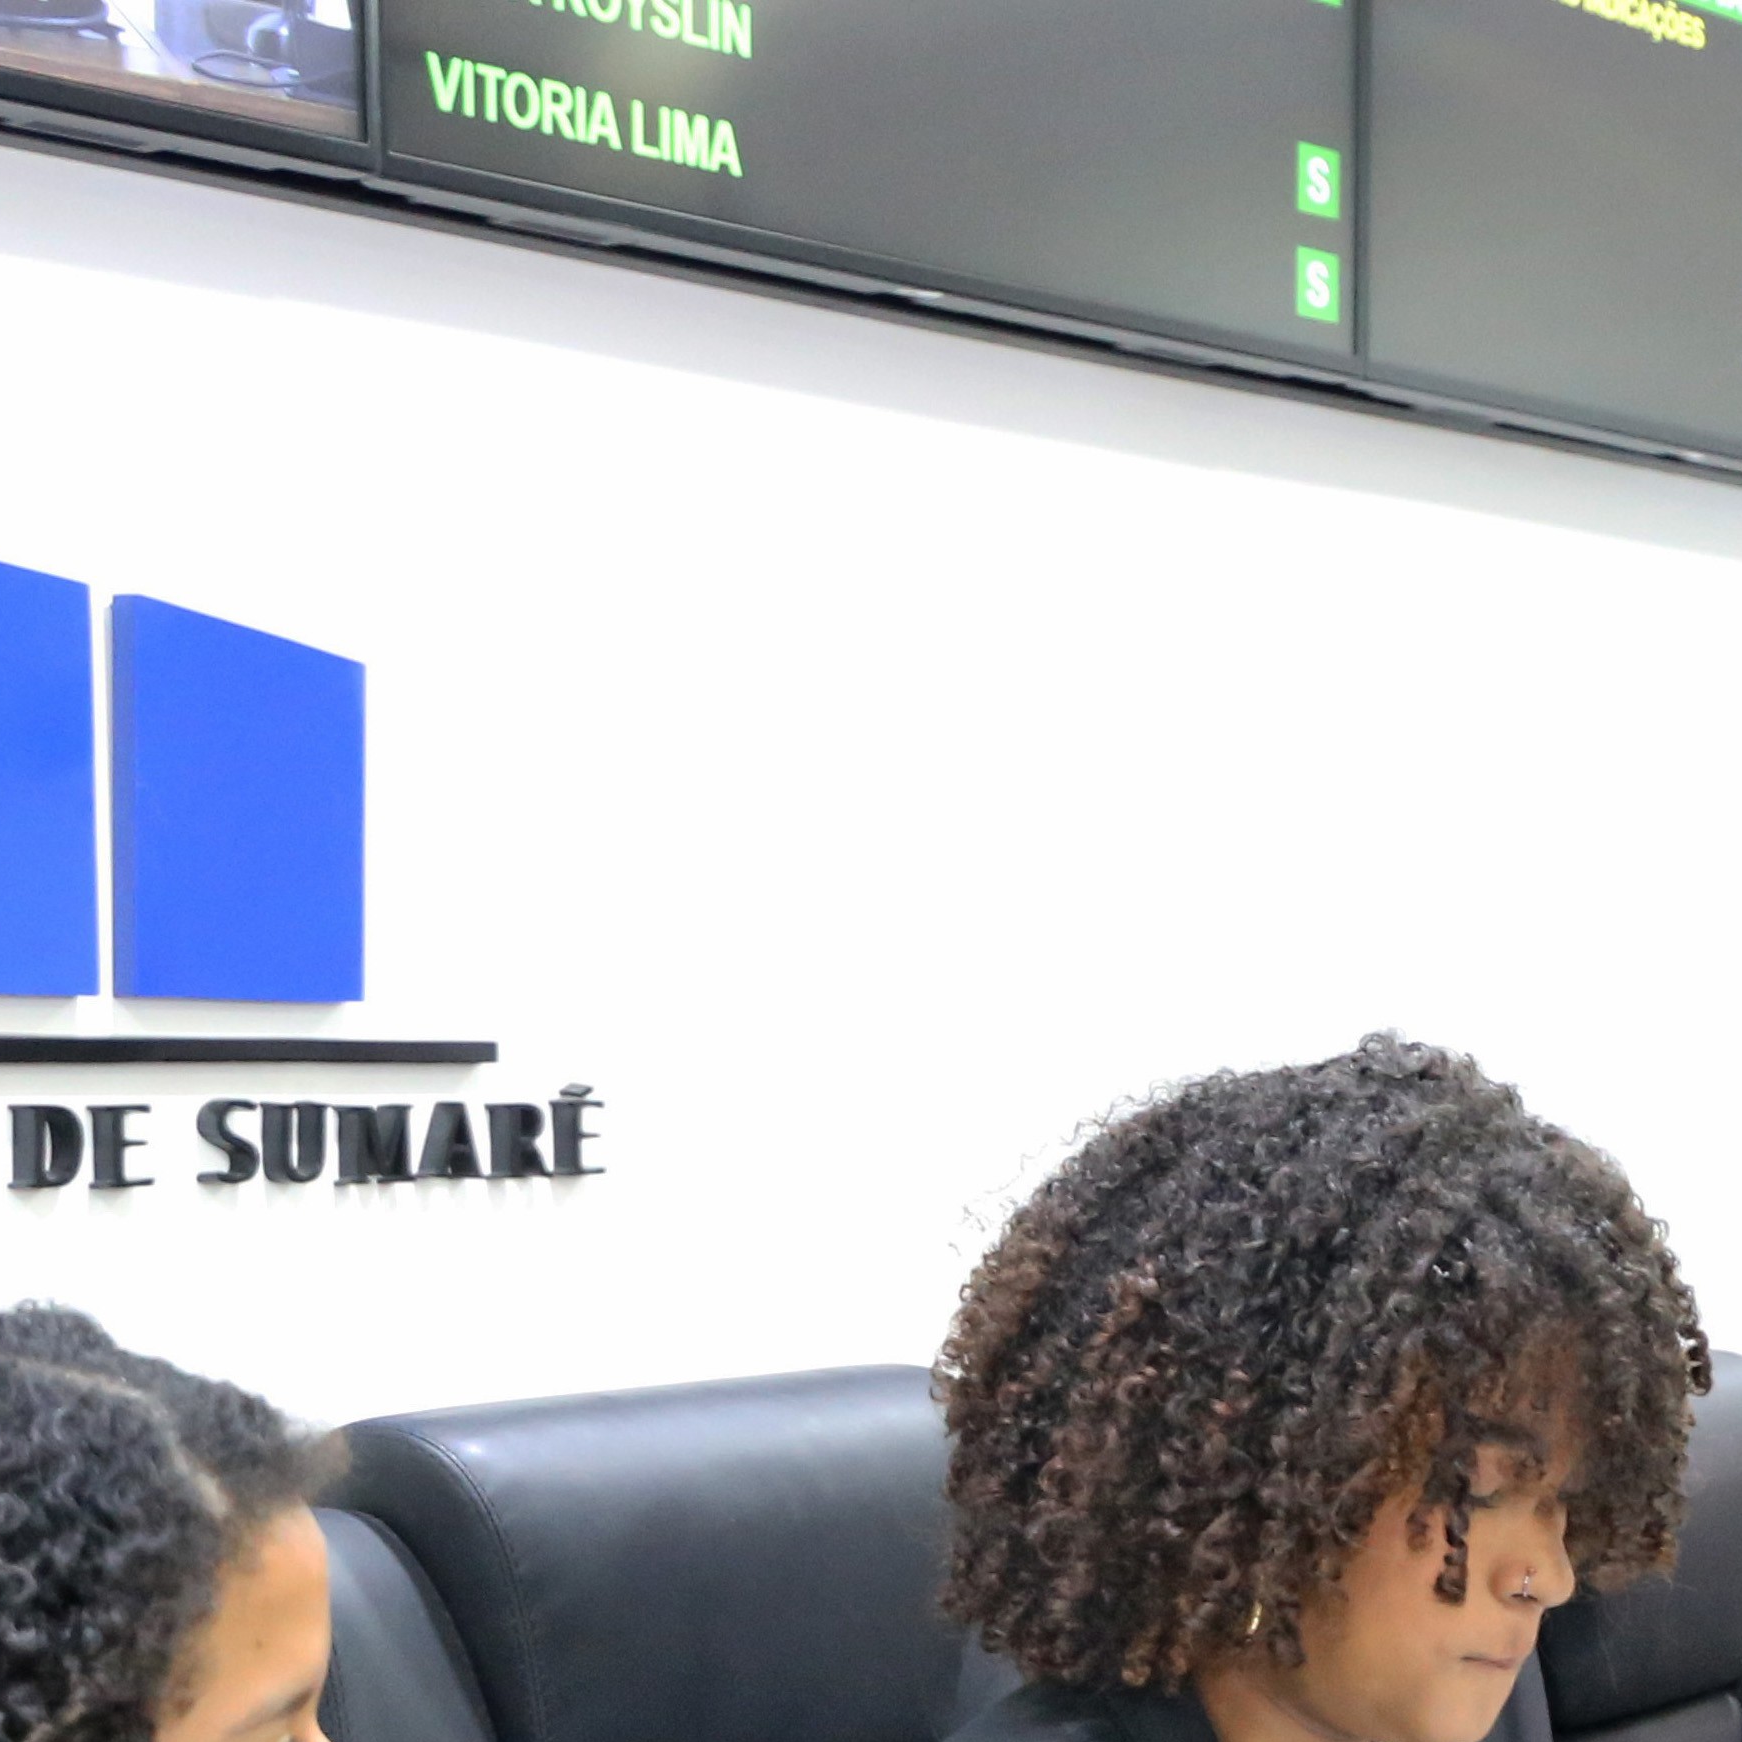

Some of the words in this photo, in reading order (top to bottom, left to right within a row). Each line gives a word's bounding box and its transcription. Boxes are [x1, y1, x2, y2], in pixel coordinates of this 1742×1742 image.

[426, 51, 623, 151] VITORIA
[630, 98, 743, 178] LIMA
[1306, 156, 1331, 204] S
[1305, 260, 1331, 309] S
[5, 1103, 154, 1191] DE
[195, 1084, 605, 1187] SUMARÉ
